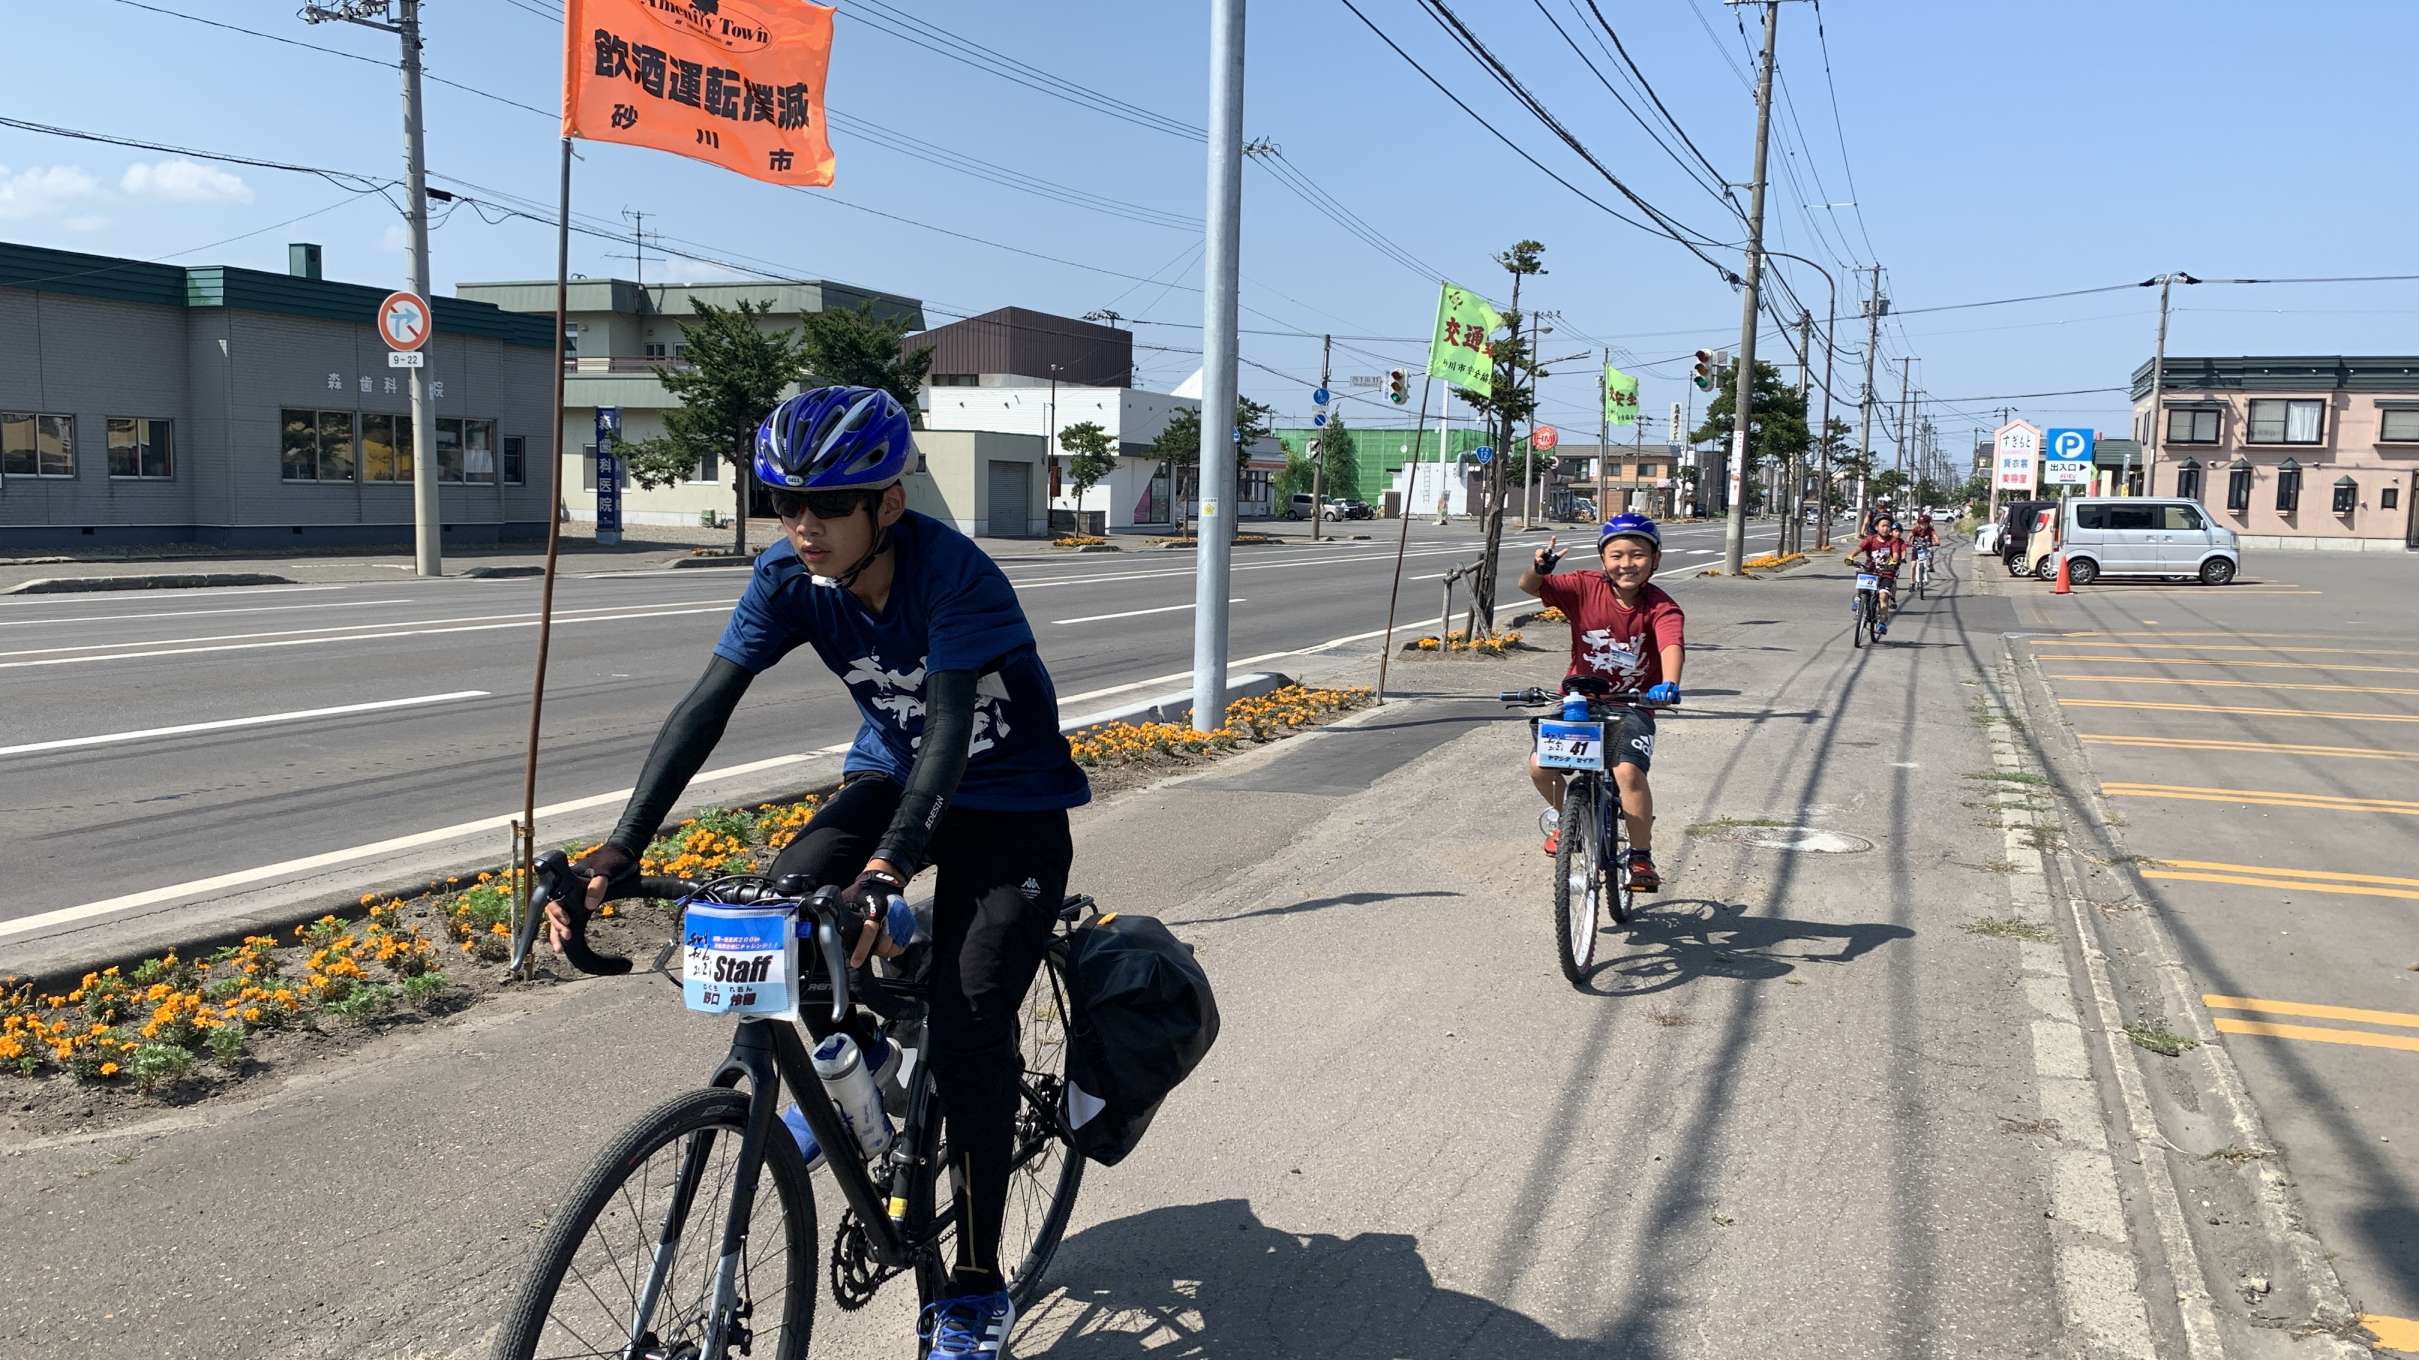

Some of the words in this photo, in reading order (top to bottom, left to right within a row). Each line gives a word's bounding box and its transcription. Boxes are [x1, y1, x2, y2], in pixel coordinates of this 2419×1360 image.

[720, 17, 768, 43] Town
[594, 28, 809, 131] 飲酒運転撲滅
[327, 372, 444, 400] 森歯科院
[2062, 436, 2080, 455] P
[2050, 463, 2077, 472] 出入口
[1570, 742, 1589, 756] 41
[714, 954, 773, 983] Staff
